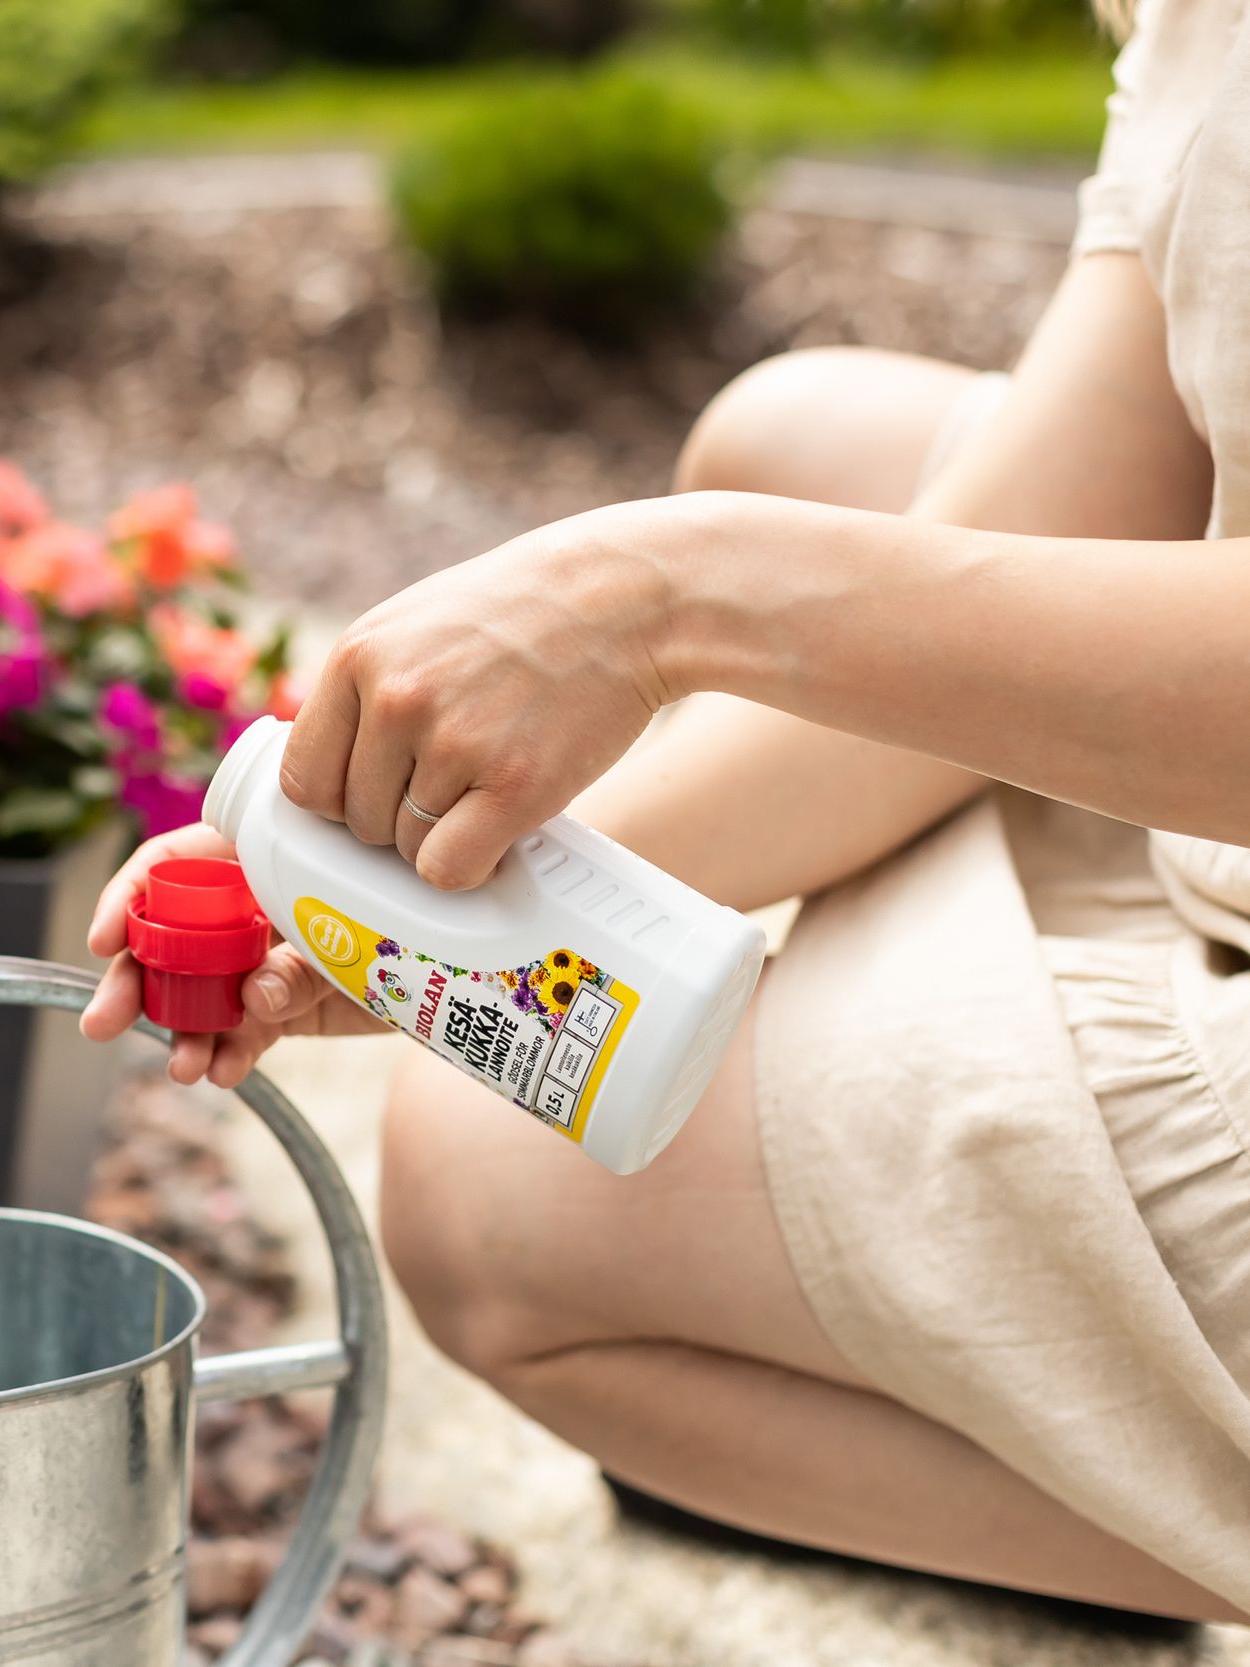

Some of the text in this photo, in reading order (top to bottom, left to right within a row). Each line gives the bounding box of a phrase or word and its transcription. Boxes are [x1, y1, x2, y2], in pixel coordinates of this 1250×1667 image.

[415, 969, 447, 1040] BIOLAN
[443, 995, 477, 1053] KESÄ-
[464, 1002, 503, 1073] KUKKA-
[487, 1017, 518, 1082] LANNOITE
[506, 1042, 529, 1084] GÖDSEL FÖR
[517, 1035, 545, 1100] SOMMARBLOMMOR
[545, 1091, 565, 1116] 0,5 L
